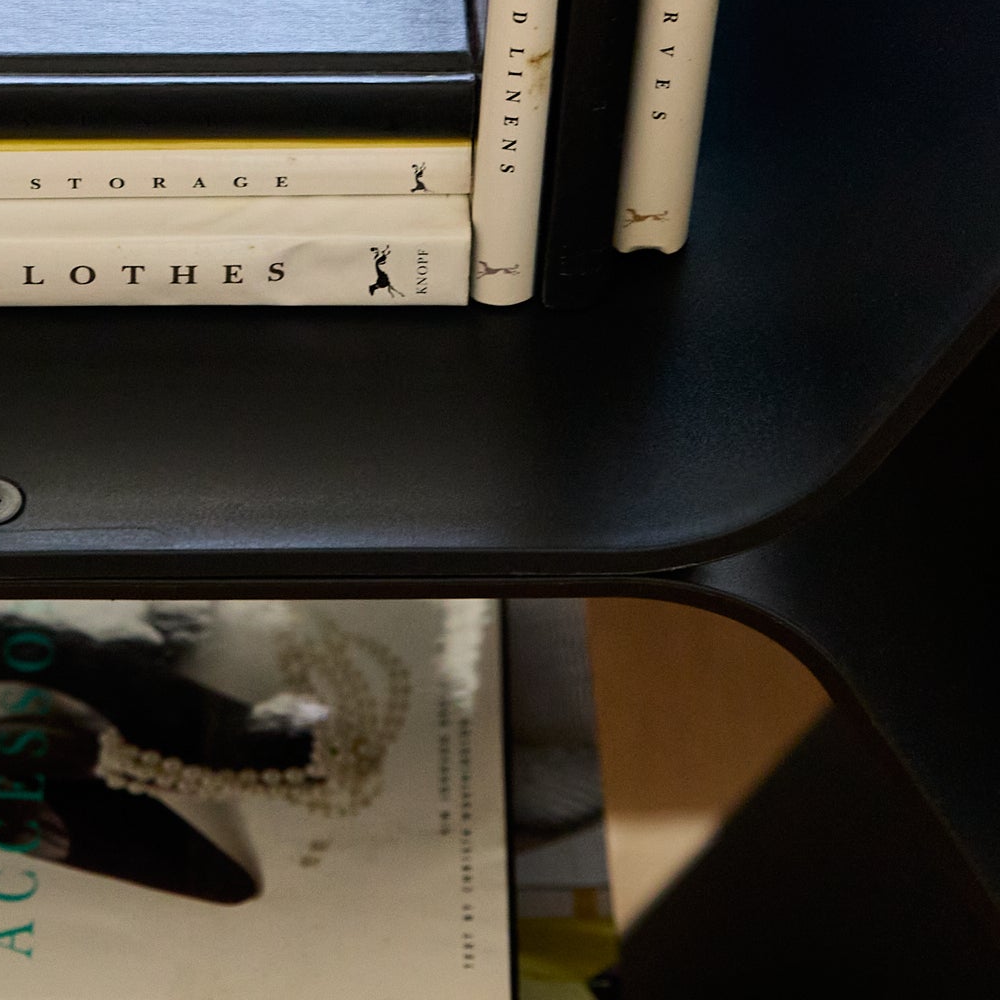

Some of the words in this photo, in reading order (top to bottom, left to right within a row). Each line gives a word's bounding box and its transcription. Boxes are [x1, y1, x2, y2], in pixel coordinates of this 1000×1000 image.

[499, 46, 526, 174] LINENS
[29, 175, 291, 191] STORAGE
[415, 248, 429, 295] KNOPF
